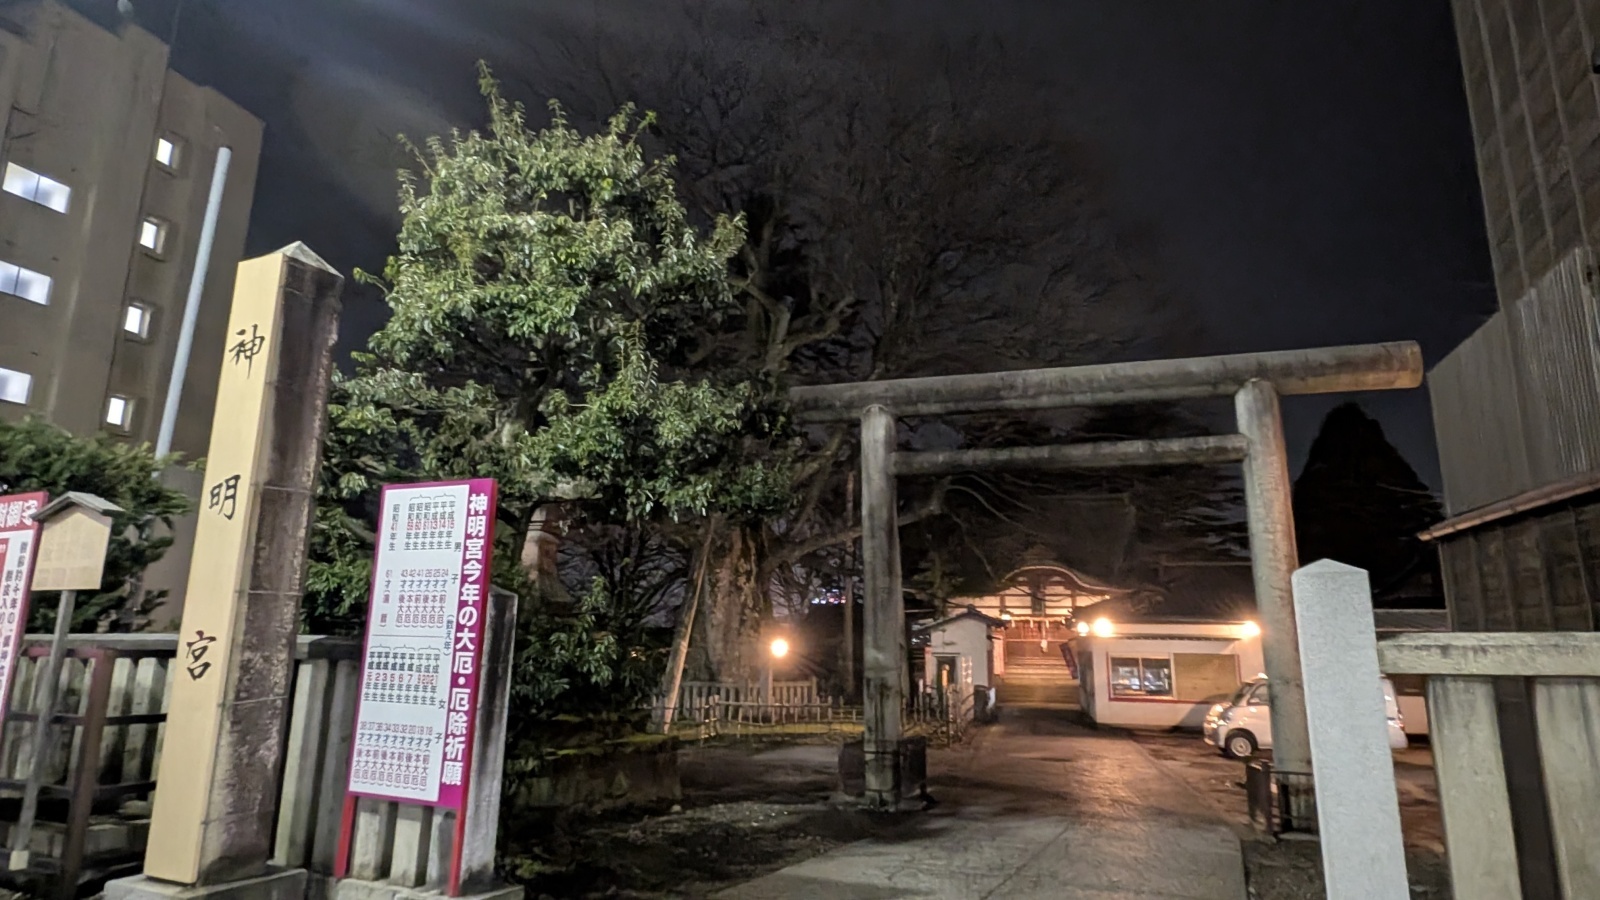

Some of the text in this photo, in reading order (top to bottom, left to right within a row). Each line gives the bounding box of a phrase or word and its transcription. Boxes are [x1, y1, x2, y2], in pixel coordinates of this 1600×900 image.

[186, 324, 266, 681] 神明宮
[441, 493, 488, 786] 神明宮今年の大厄・厄除祈願
